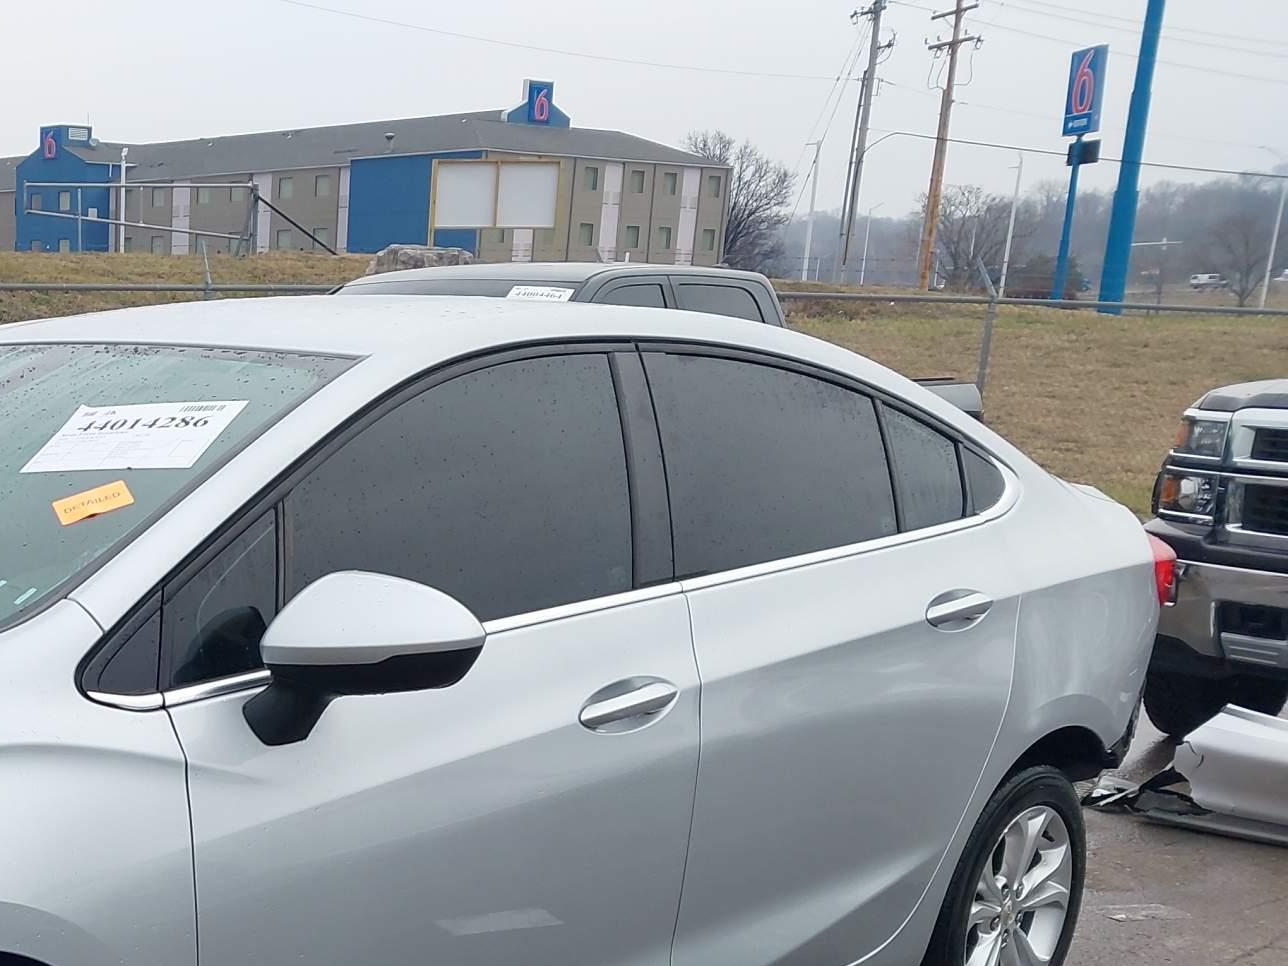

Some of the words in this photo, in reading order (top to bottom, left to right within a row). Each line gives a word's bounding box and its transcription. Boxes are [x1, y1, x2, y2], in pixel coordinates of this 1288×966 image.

[1072, 48, 1094, 114] 6
[534, 88, 549, 121] 6
[43, 130, 56, 159] 6
[77, 415, 213, 433] 44014286
[63, 491, 121, 514] DETAILED
